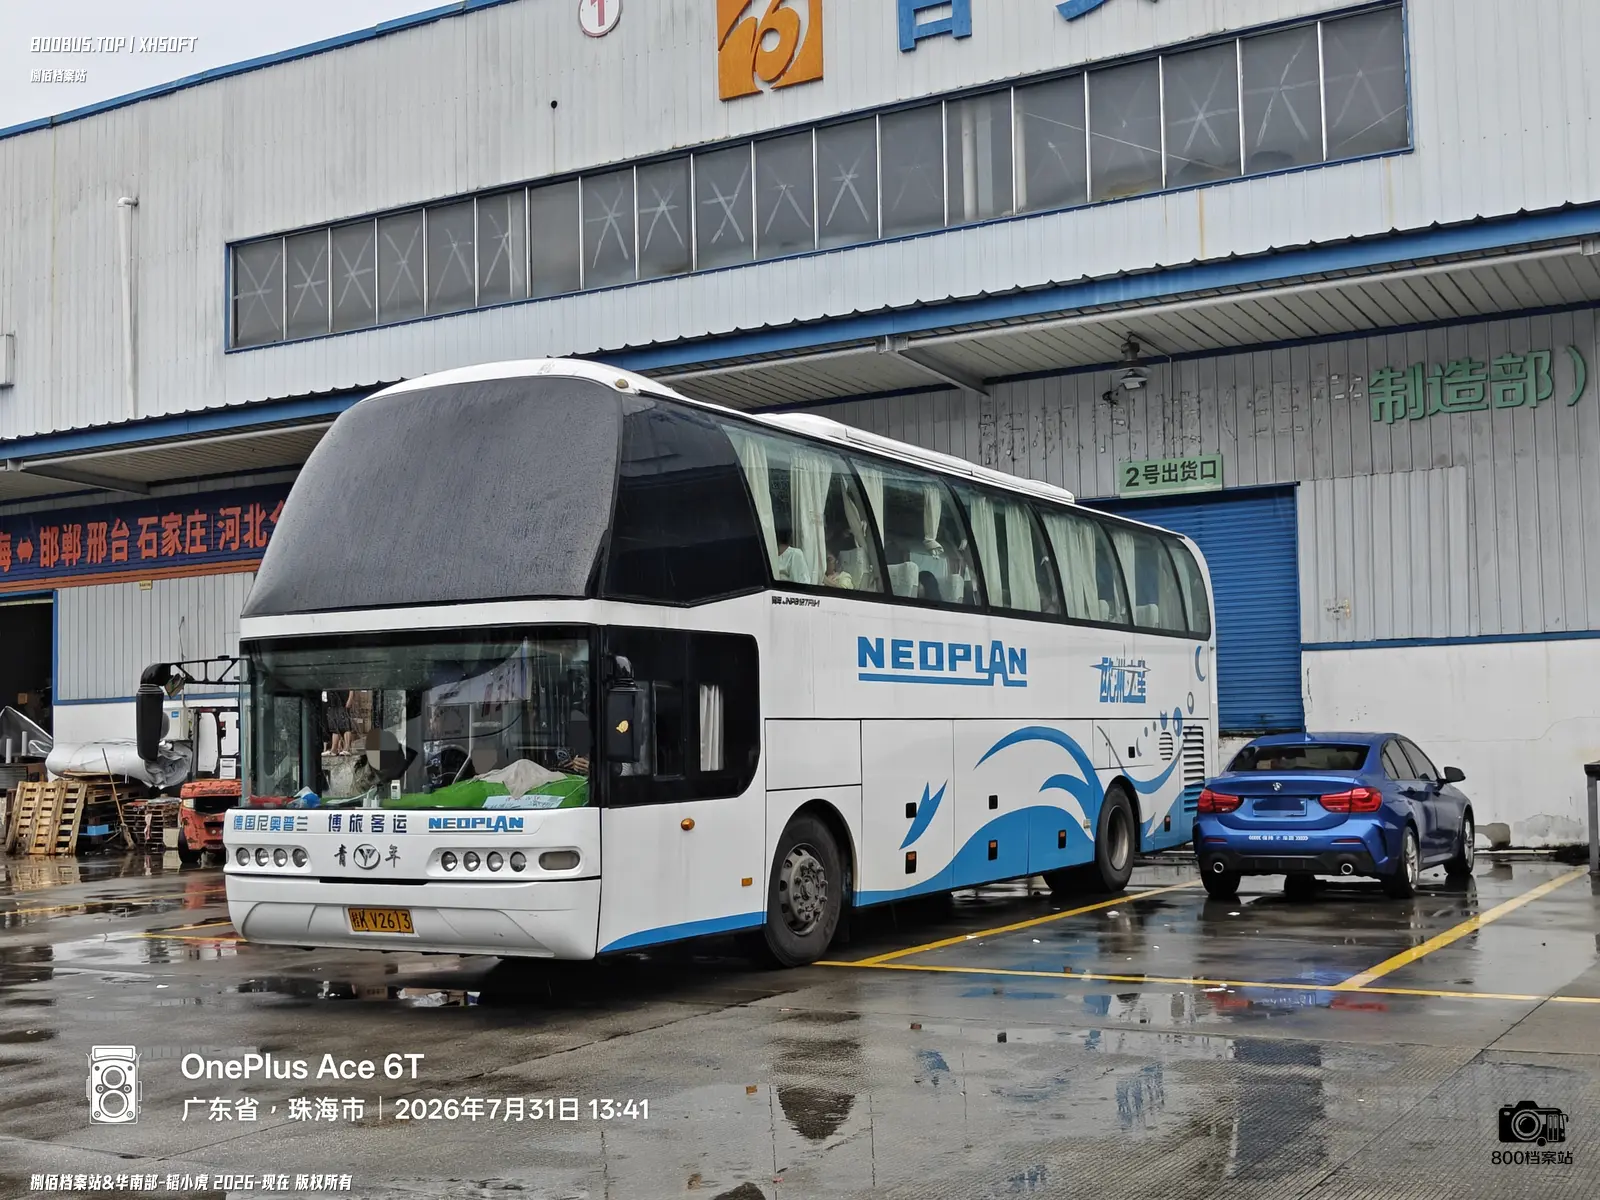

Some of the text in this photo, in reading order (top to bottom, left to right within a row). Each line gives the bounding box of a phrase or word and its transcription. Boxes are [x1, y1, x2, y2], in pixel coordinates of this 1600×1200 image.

[1125, 460, 1217, 488] 2号出货口
[857, 636, 1027, 687] NEOPLAN
[328, 813, 407, 833] 博旅客运
[428, 815, 525, 833] NEOPLAN
